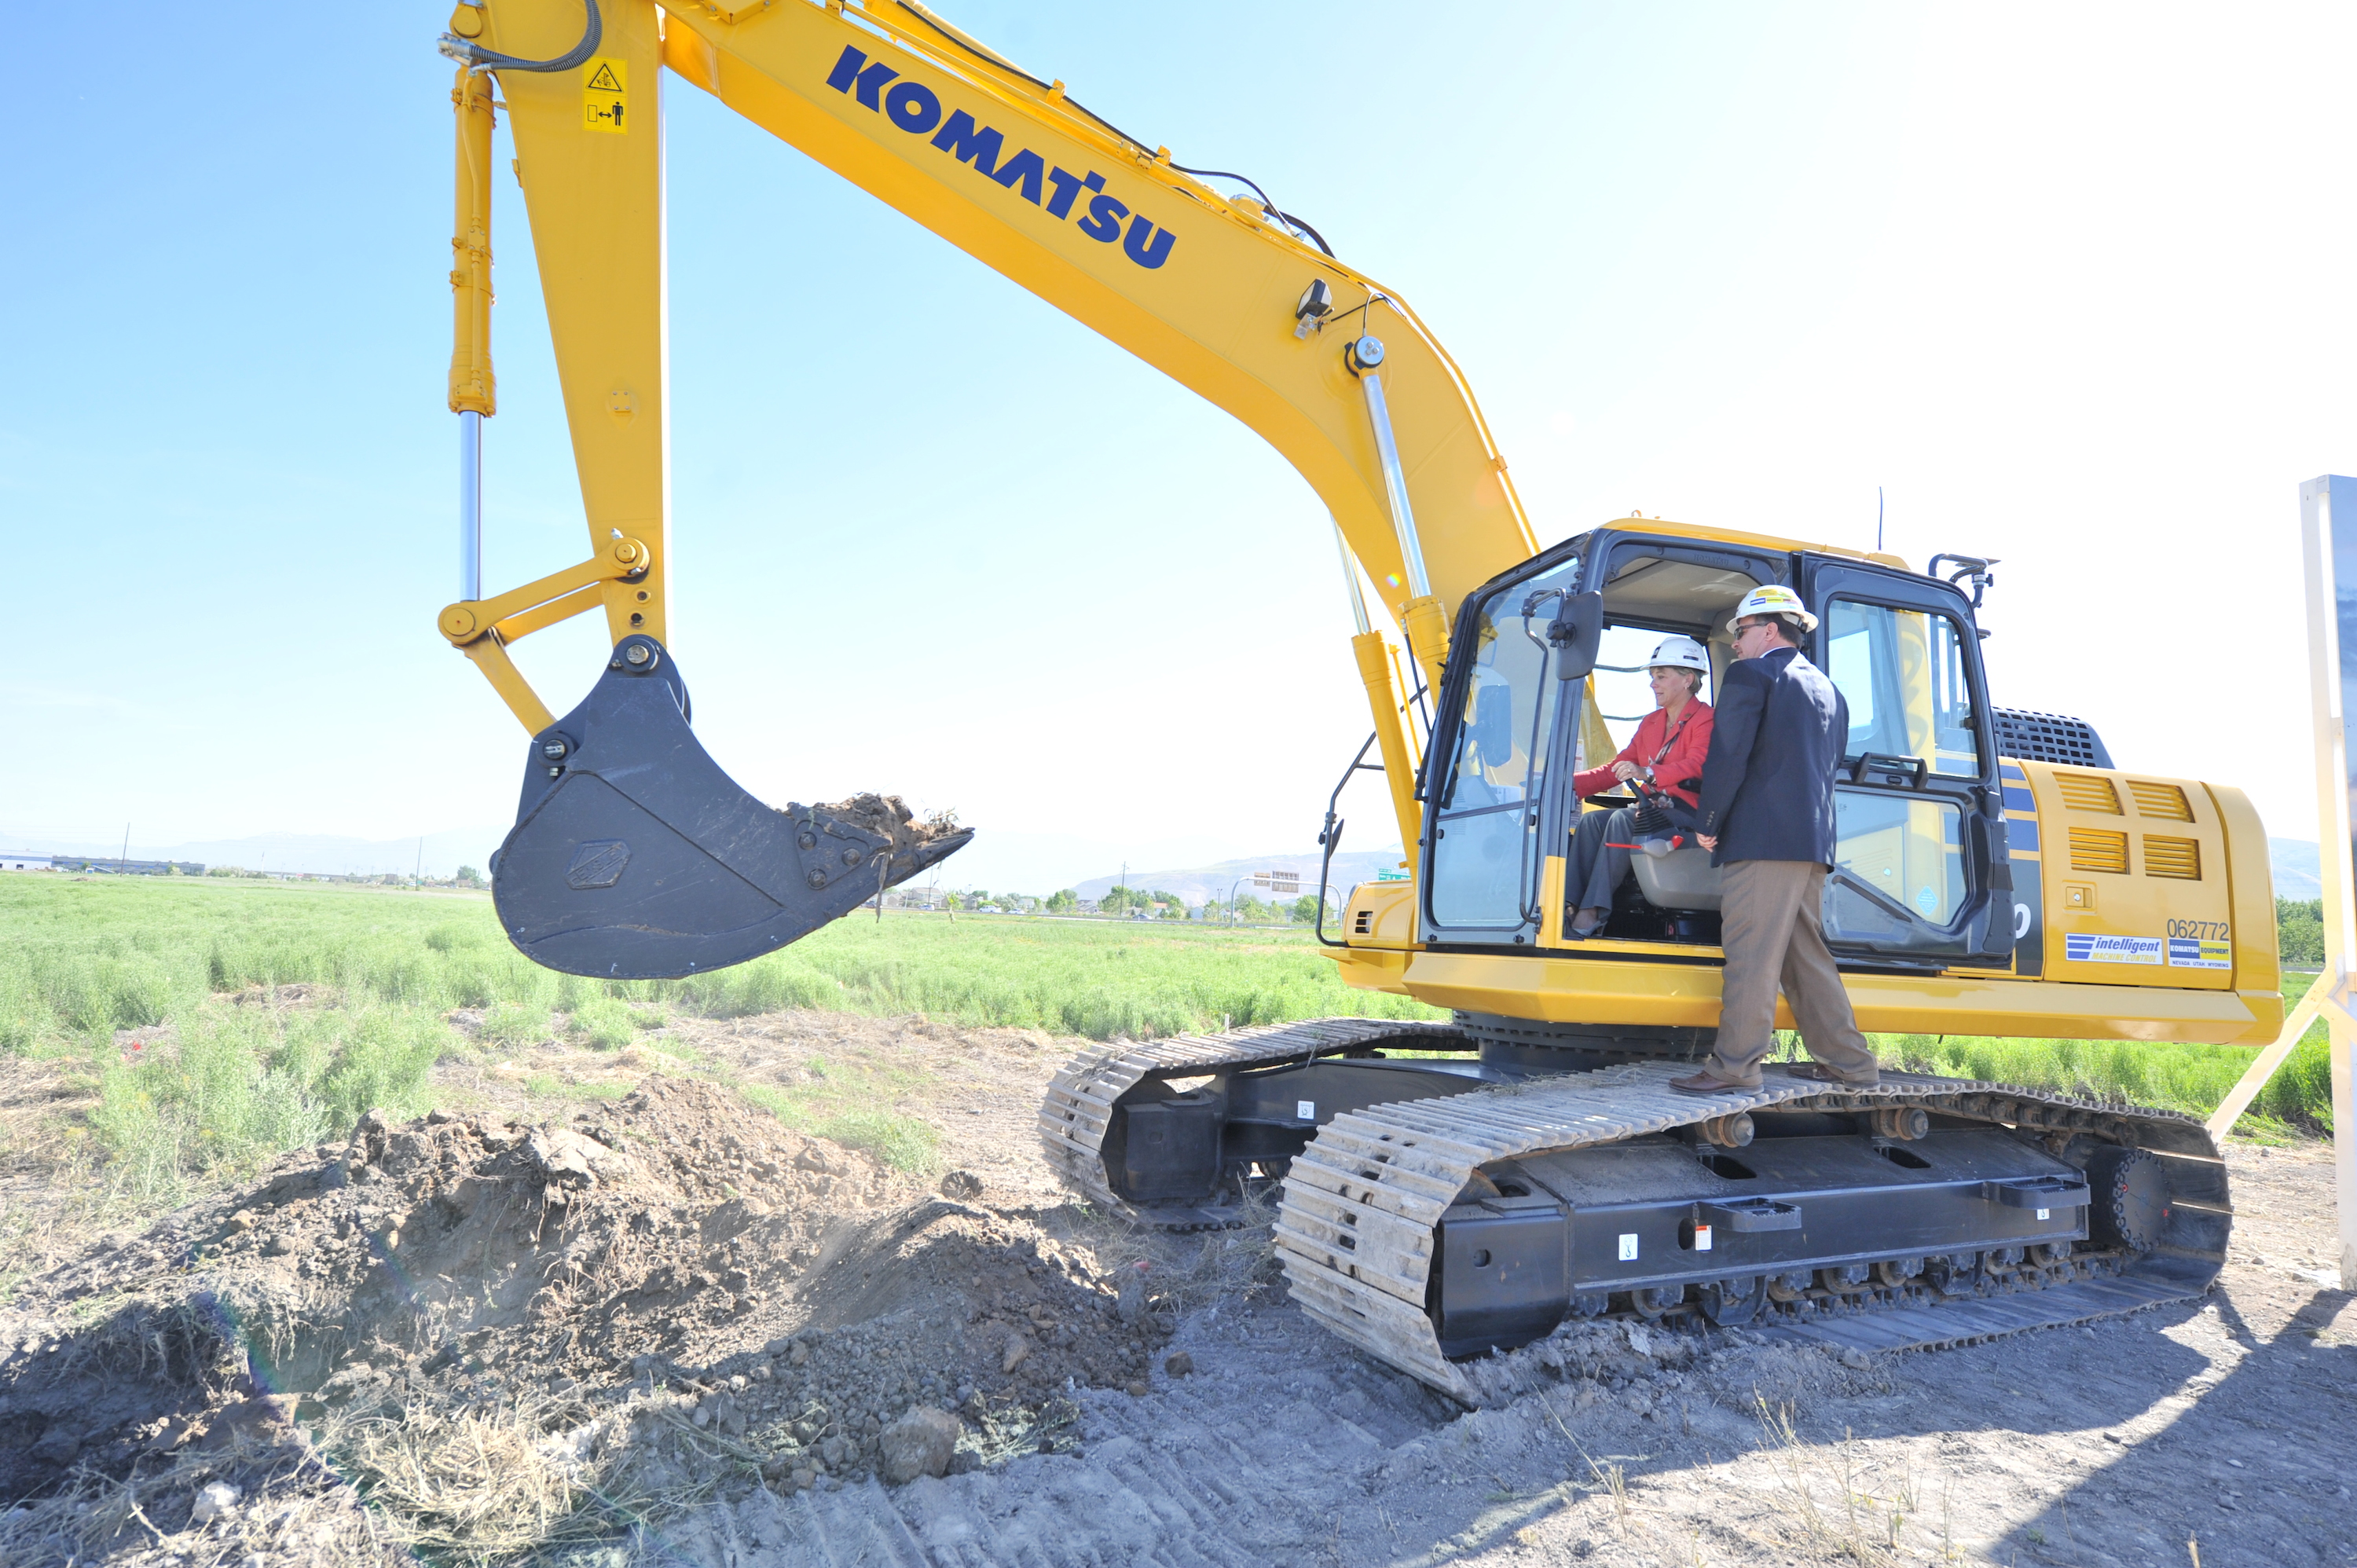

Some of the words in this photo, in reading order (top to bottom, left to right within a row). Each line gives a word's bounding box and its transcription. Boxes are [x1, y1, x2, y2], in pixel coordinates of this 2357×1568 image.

[826, 44, 1177, 269] KOMATSU
[2167, 918, 2230, 941] 062772
[2095, 937, 2160, 954] intelligent
[2170, 945, 2199, 954] KOMATSU
[2091, 952, 2124, 962] MACHINE
[2125, 954, 2157, 963] CONTROL
